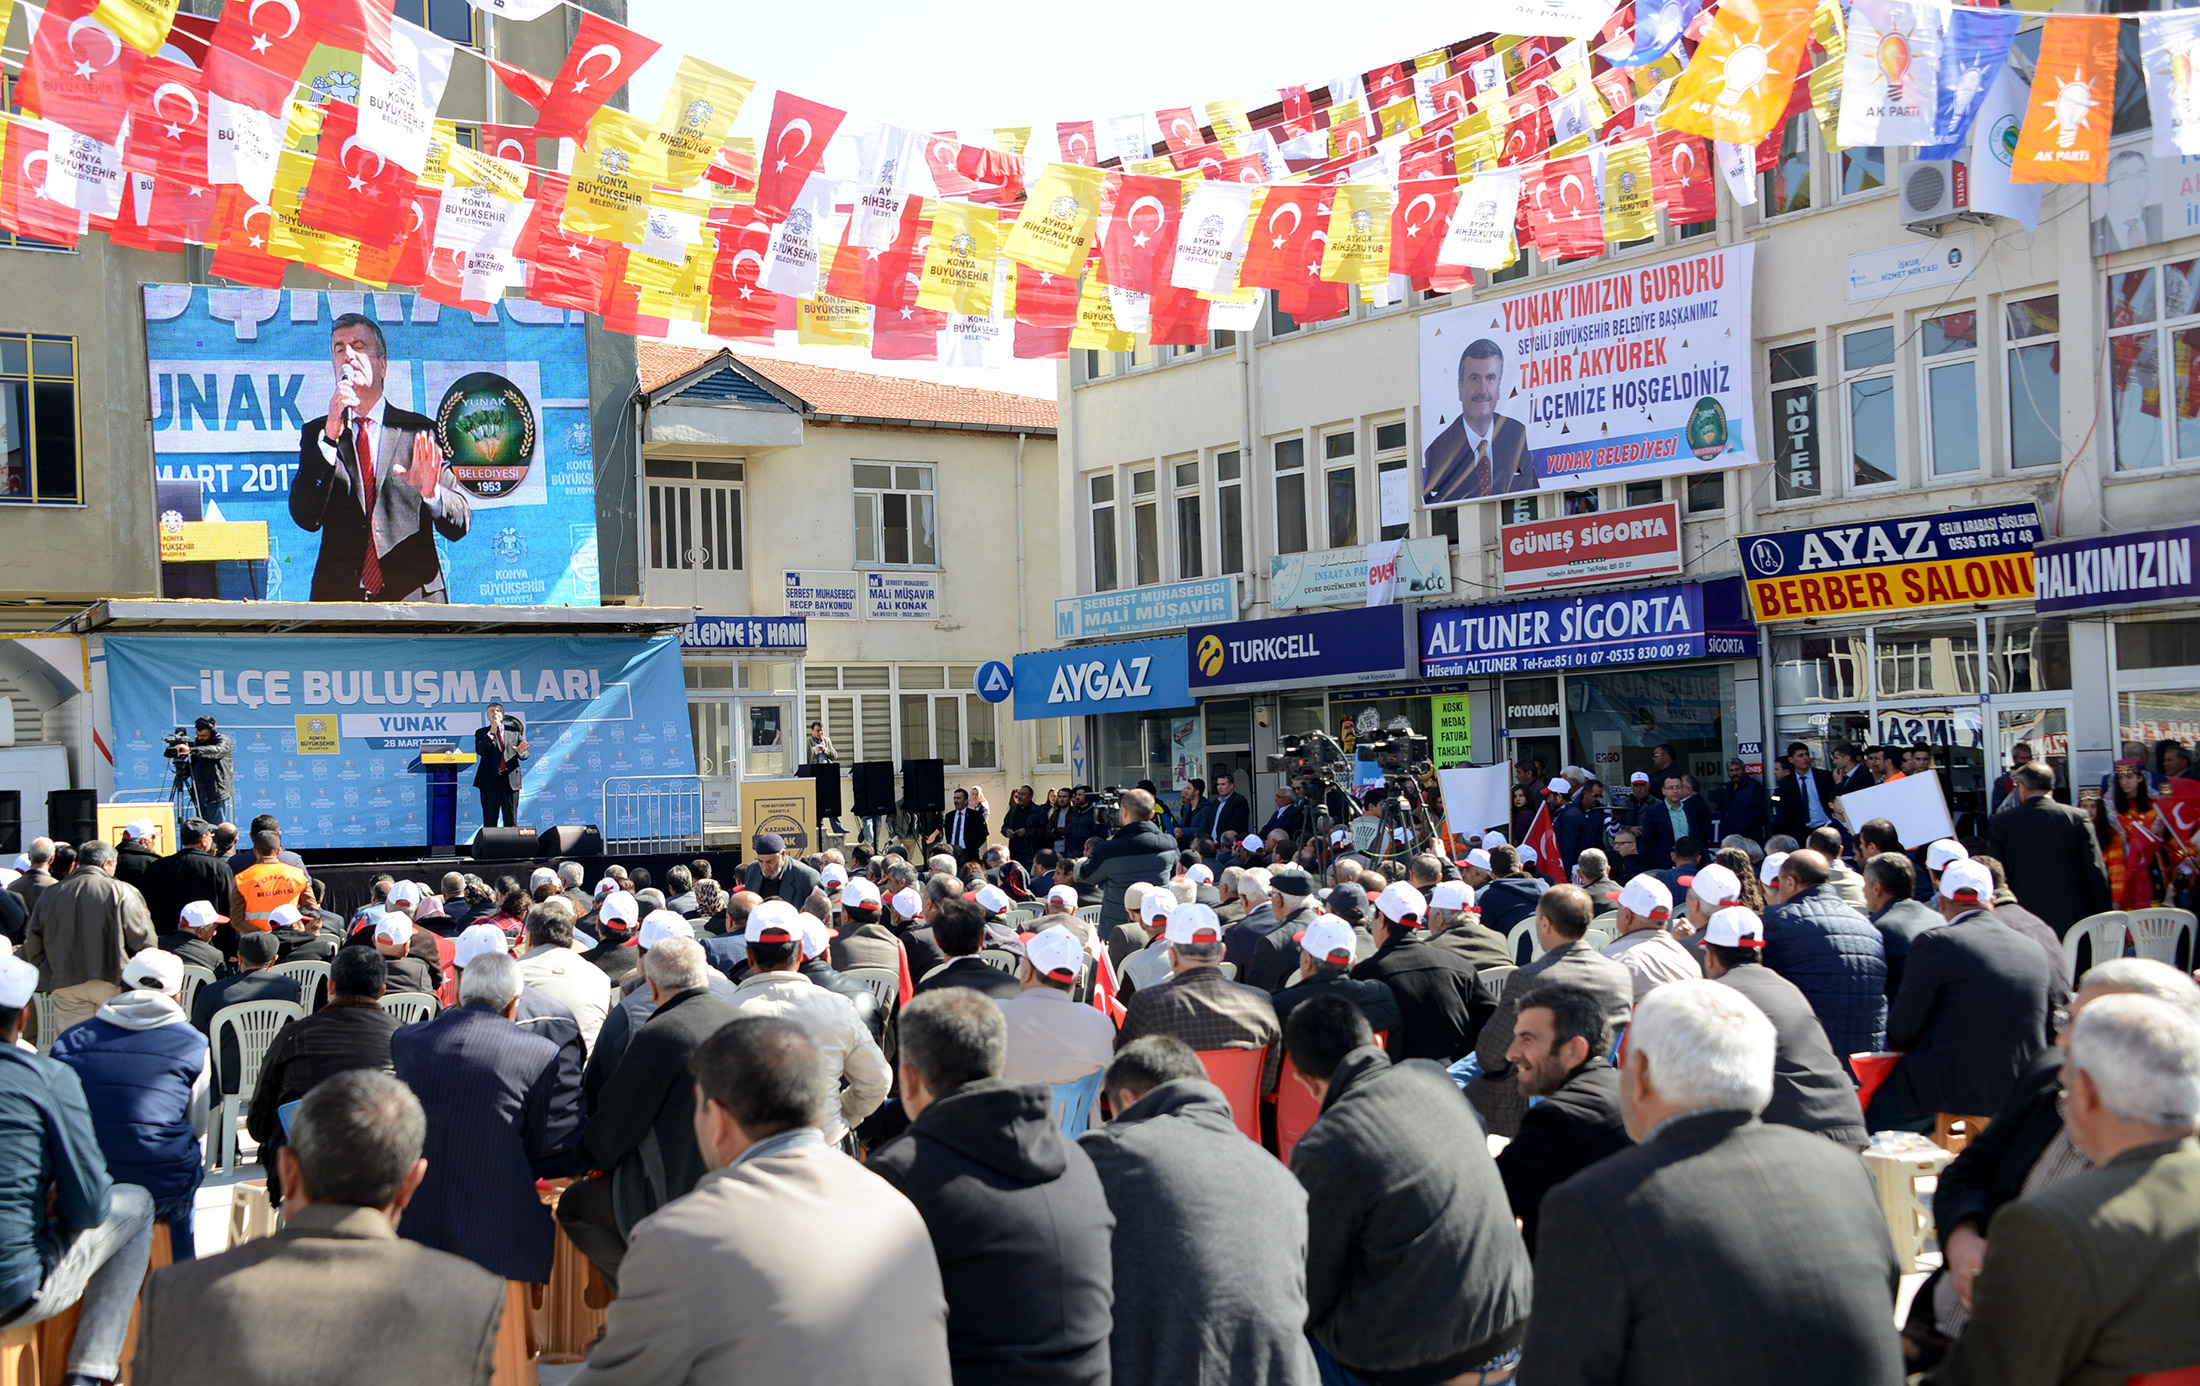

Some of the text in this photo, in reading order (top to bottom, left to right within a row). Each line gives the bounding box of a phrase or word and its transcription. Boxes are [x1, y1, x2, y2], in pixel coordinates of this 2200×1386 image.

[388, 91, 415, 112] KONYA
[1689, 100, 1710, 115] AK
[1866, 106, 1886, 117] AK
[69, 149, 102, 165] KONYA
[2033, 150, 2054, 162] AK
[53, 153, 117, 181] BÜYÜKŞEHİR
[596, 174, 629, 190] KONYA
[1956, 169, 1965, 206] VESTEL
[577, 181, 643, 206] BÜYÜKŞEHİR
[461, 197, 492, 211] KONYA
[589, 197, 629, 212] BELEDİYESİ
[445, 204, 506, 223] BÜYÜKŞEHİR
[782, 232, 809, 248] KONYA
[947, 257, 976, 269] KONYA
[930, 265, 989, 282] BÜYÜKŞEHİR
[1639, 253, 1725, 304] GURURU
[1880, 270, 1907, 283] HİZMET
[1553, 319, 1611, 347] BÜYÜKŞEHİR
[1612, 310, 1656, 338] BELEDİYE
[1659, 300, 1718, 331] BAŞKANIMIZ
[1520, 336, 1667, 390] TAHİR AKYÜREK
[462, 397, 507, 407] YUNAK
[1529, 363, 1730, 428] İLÇEMİZE HOŞGELDİNİZ
[1786, 395, 1813, 490] NOTER
[1547, 433, 1679, 474] YUNAK BELEDİYESİ
[240, 463, 301, 492] 201
[477, 481, 502, 493] 1953
[1509, 517, 1669, 556] GÜNEŞ SİGORTA
[1797, 520, 1938, 572] AYAZ
[1963, 517, 1998, 533] ARABASI
[1948, 529, 2035, 551] 0536 873 47 48
[495, 568, 528, 579] KONYA
[1547, 567, 1566, 579] Hüseyin
[1567, 566, 1585, 576] Altuner
[2033, 538, 2192, 600] HALKIMIZIN
[885, 579, 904, 587] SERBEST
[1304, 583, 1322, 594] ÇEVRE
[1323, 581, 1357, 593] DÜZENLEME
[785, 588, 814, 599] SERBEST
[1756, 571, 1894, 618] BERBER
[790, 600, 853, 611] RECEP BAYKONDU
[894, 601, 928, 610] KONAK
[1084, 593, 1137, 611] SERBEST
[1085, 606, 1129, 627] MALİ
[1136, 595, 1225, 620] MÜŞAVİR
[1427, 595, 1692, 656] ALTUNER SİGORTA
[766, 622, 805, 646] HANI
[1229, 633, 1320, 664] TURKCELL
[1708, 634, 1745, 654] SİGORTA
[1466, 657, 1518, 675] ALTUNER
[1575, 653, 1588, 666] 01
[1590, 651, 1604, 664] 07
[1637, 647, 1659, 660] 830
[1660, 645, 1675, 658] 00
[1676, 643, 1690, 656] 92
[1047, 656, 1152, 704] AYGAZ
[1357, 673, 1370, 681] Yunak
[303, 668, 601, 709] BULUŞMALARI
[378, 716, 449, 732] YUNAK
[1441, 716, 1466, 730] MEDAŞ
[383, 738, 425, 748] 28 MART
[1441, 730, 1468, 742] FATURA
[1740, 743, 1759, 753] AXA
[1596, 752, 1620, 763] ERGO
[1695, 761, 1721, 777] HDI
